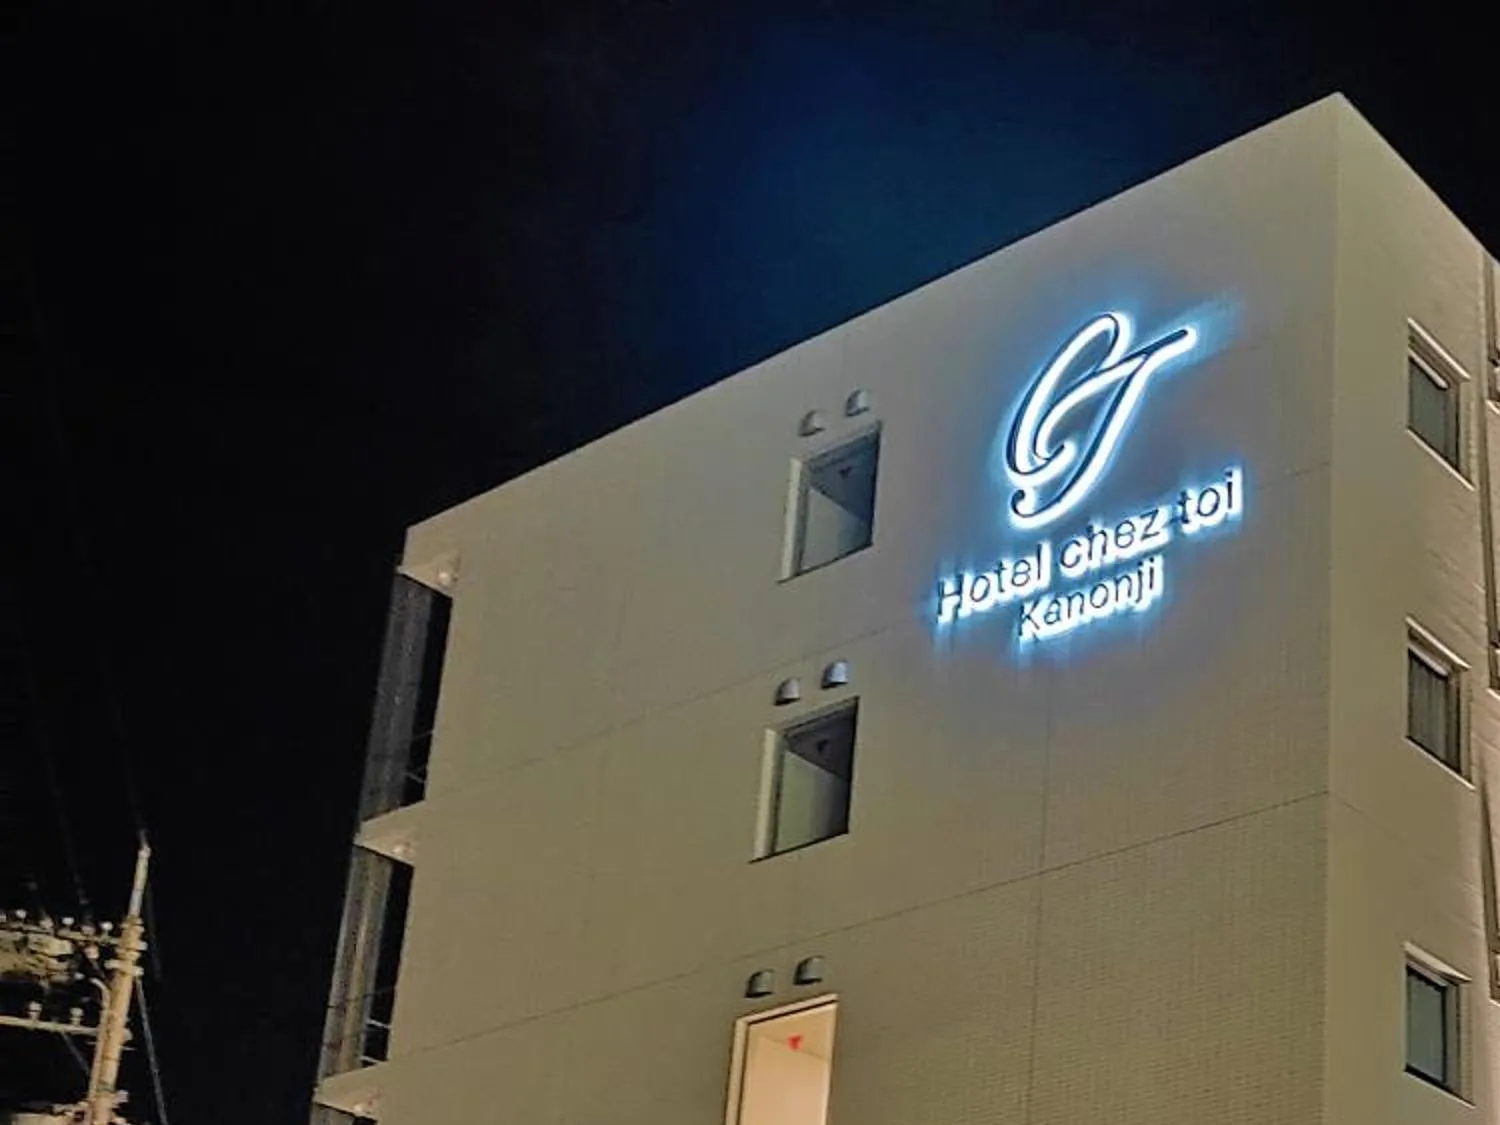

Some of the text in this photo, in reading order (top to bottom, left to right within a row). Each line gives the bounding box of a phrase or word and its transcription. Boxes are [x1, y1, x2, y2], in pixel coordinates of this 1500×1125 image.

[937, 468, 1243, 624] Hotel chez toi
[1017, 556, 1163, 641] Kanonji
